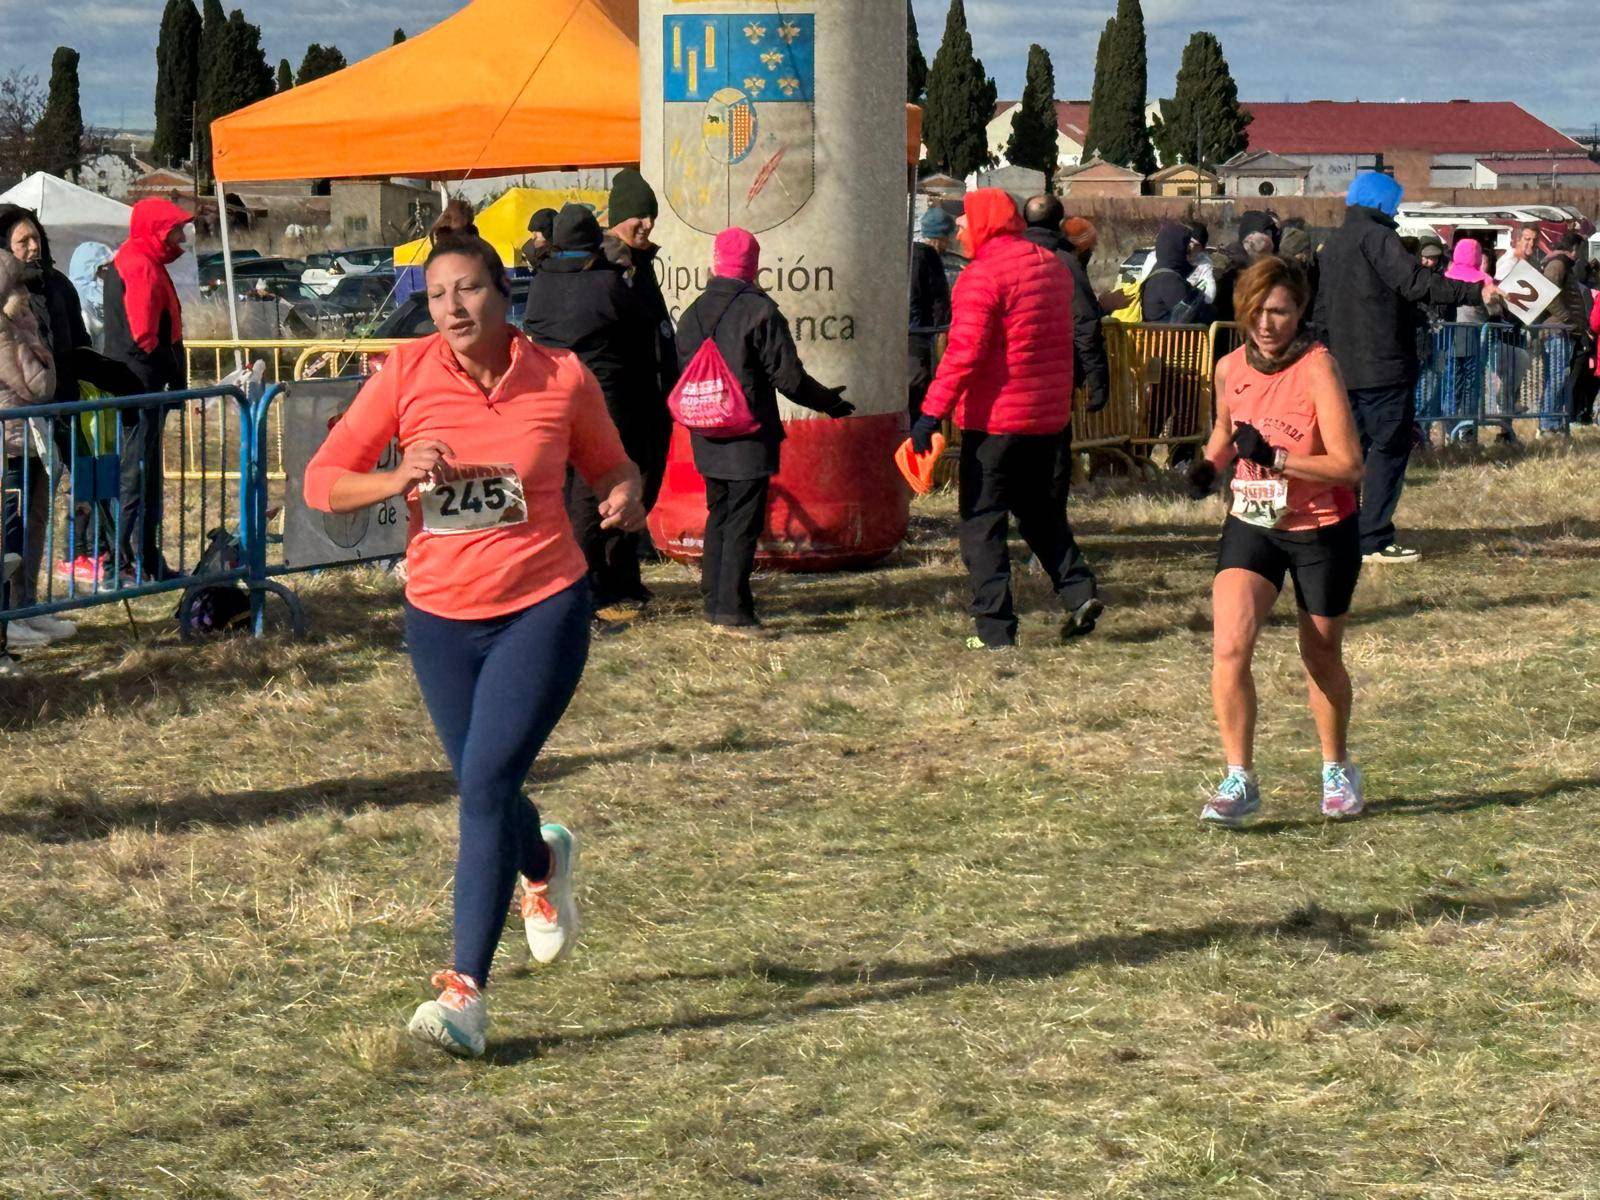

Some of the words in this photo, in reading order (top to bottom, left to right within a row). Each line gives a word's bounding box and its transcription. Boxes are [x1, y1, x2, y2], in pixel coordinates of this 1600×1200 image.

[1507, 279, 1539, 312] 2
[435, 477, 507, 516] 245
[377, 502, 397, 525] de
